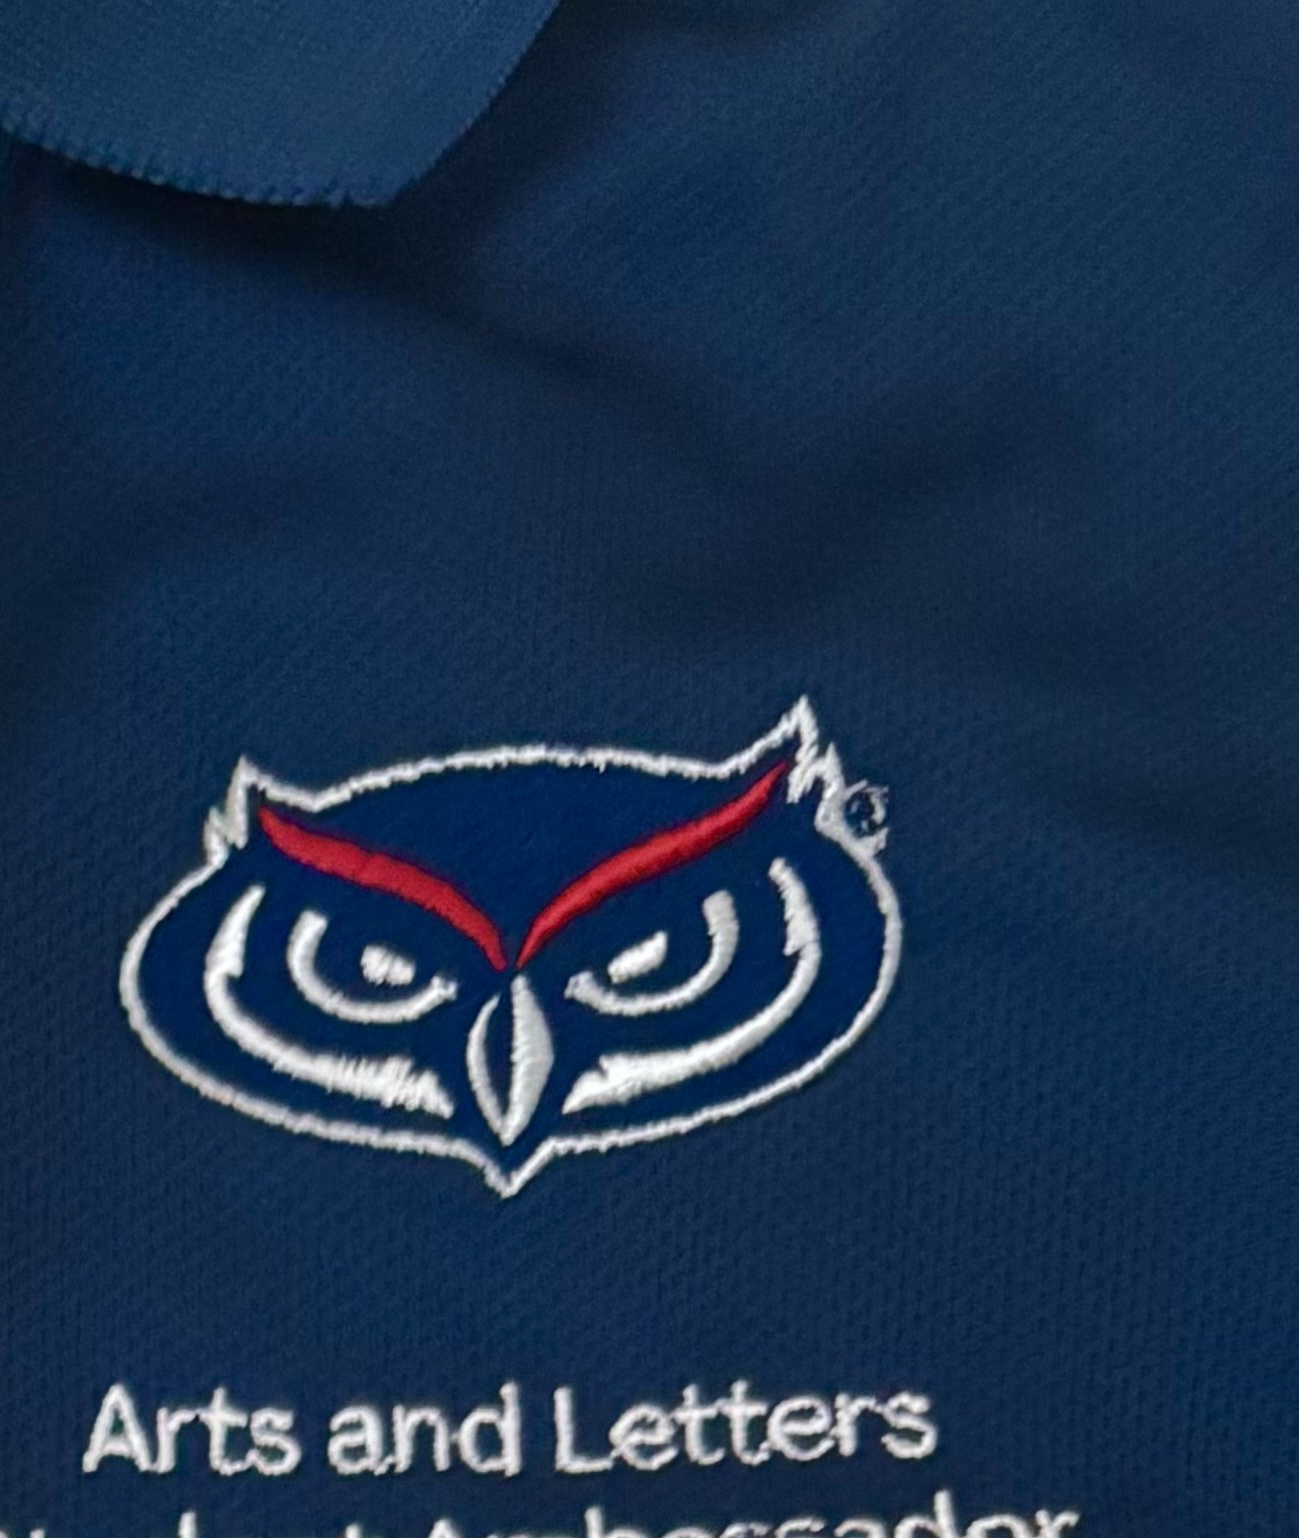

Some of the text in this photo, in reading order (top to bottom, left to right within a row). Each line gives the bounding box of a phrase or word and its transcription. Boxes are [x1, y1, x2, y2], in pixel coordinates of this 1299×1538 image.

[83, 1381, 938, 1477] Arts and Letters
